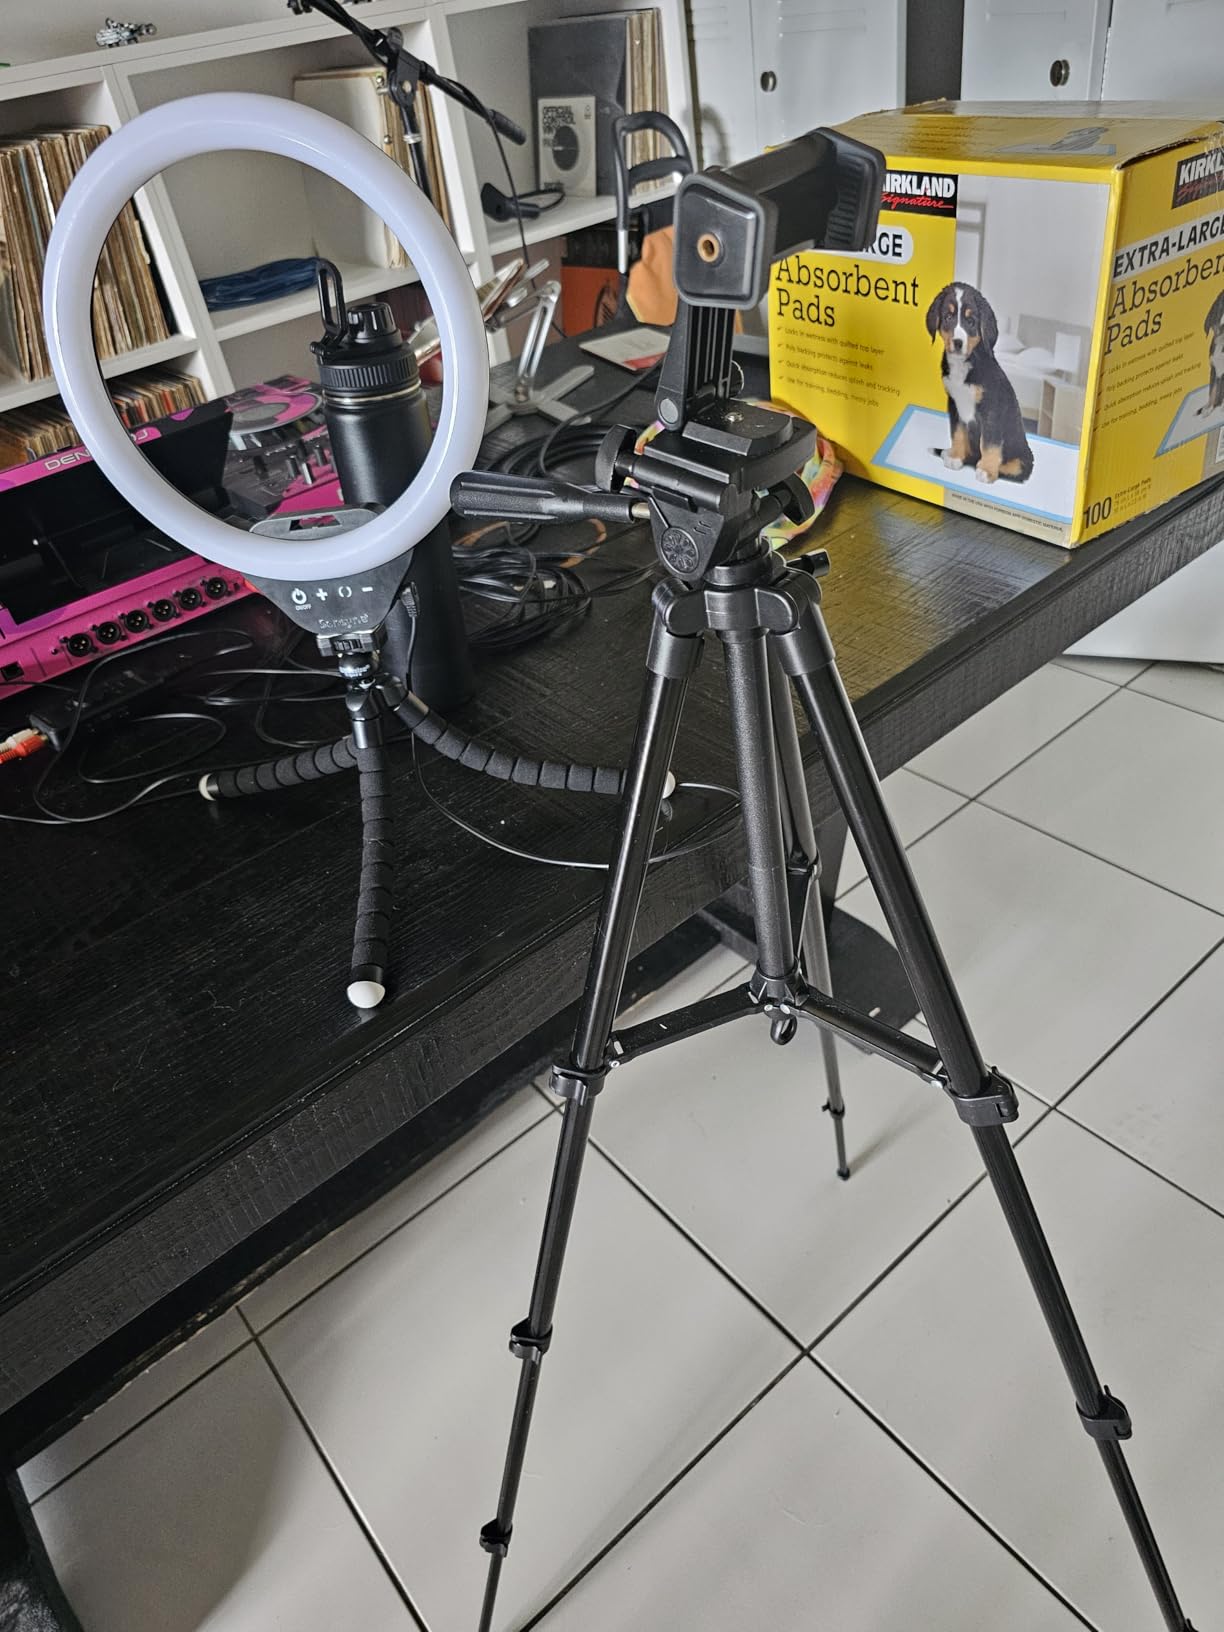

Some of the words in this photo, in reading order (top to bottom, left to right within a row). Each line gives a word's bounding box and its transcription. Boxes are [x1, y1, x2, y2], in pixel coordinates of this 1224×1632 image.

[1179, 150, 1224, 186] KIRKL
[776, 255, 919, 307] Absorbent
[1107, 253, 1224, 320] Absorben
[777, 287, 835, 327] Pads
[1104, 309, 1163, 356] Pads
[45, 449, 91, 471] DEN
[1083, 496, 1112, 529] 100
